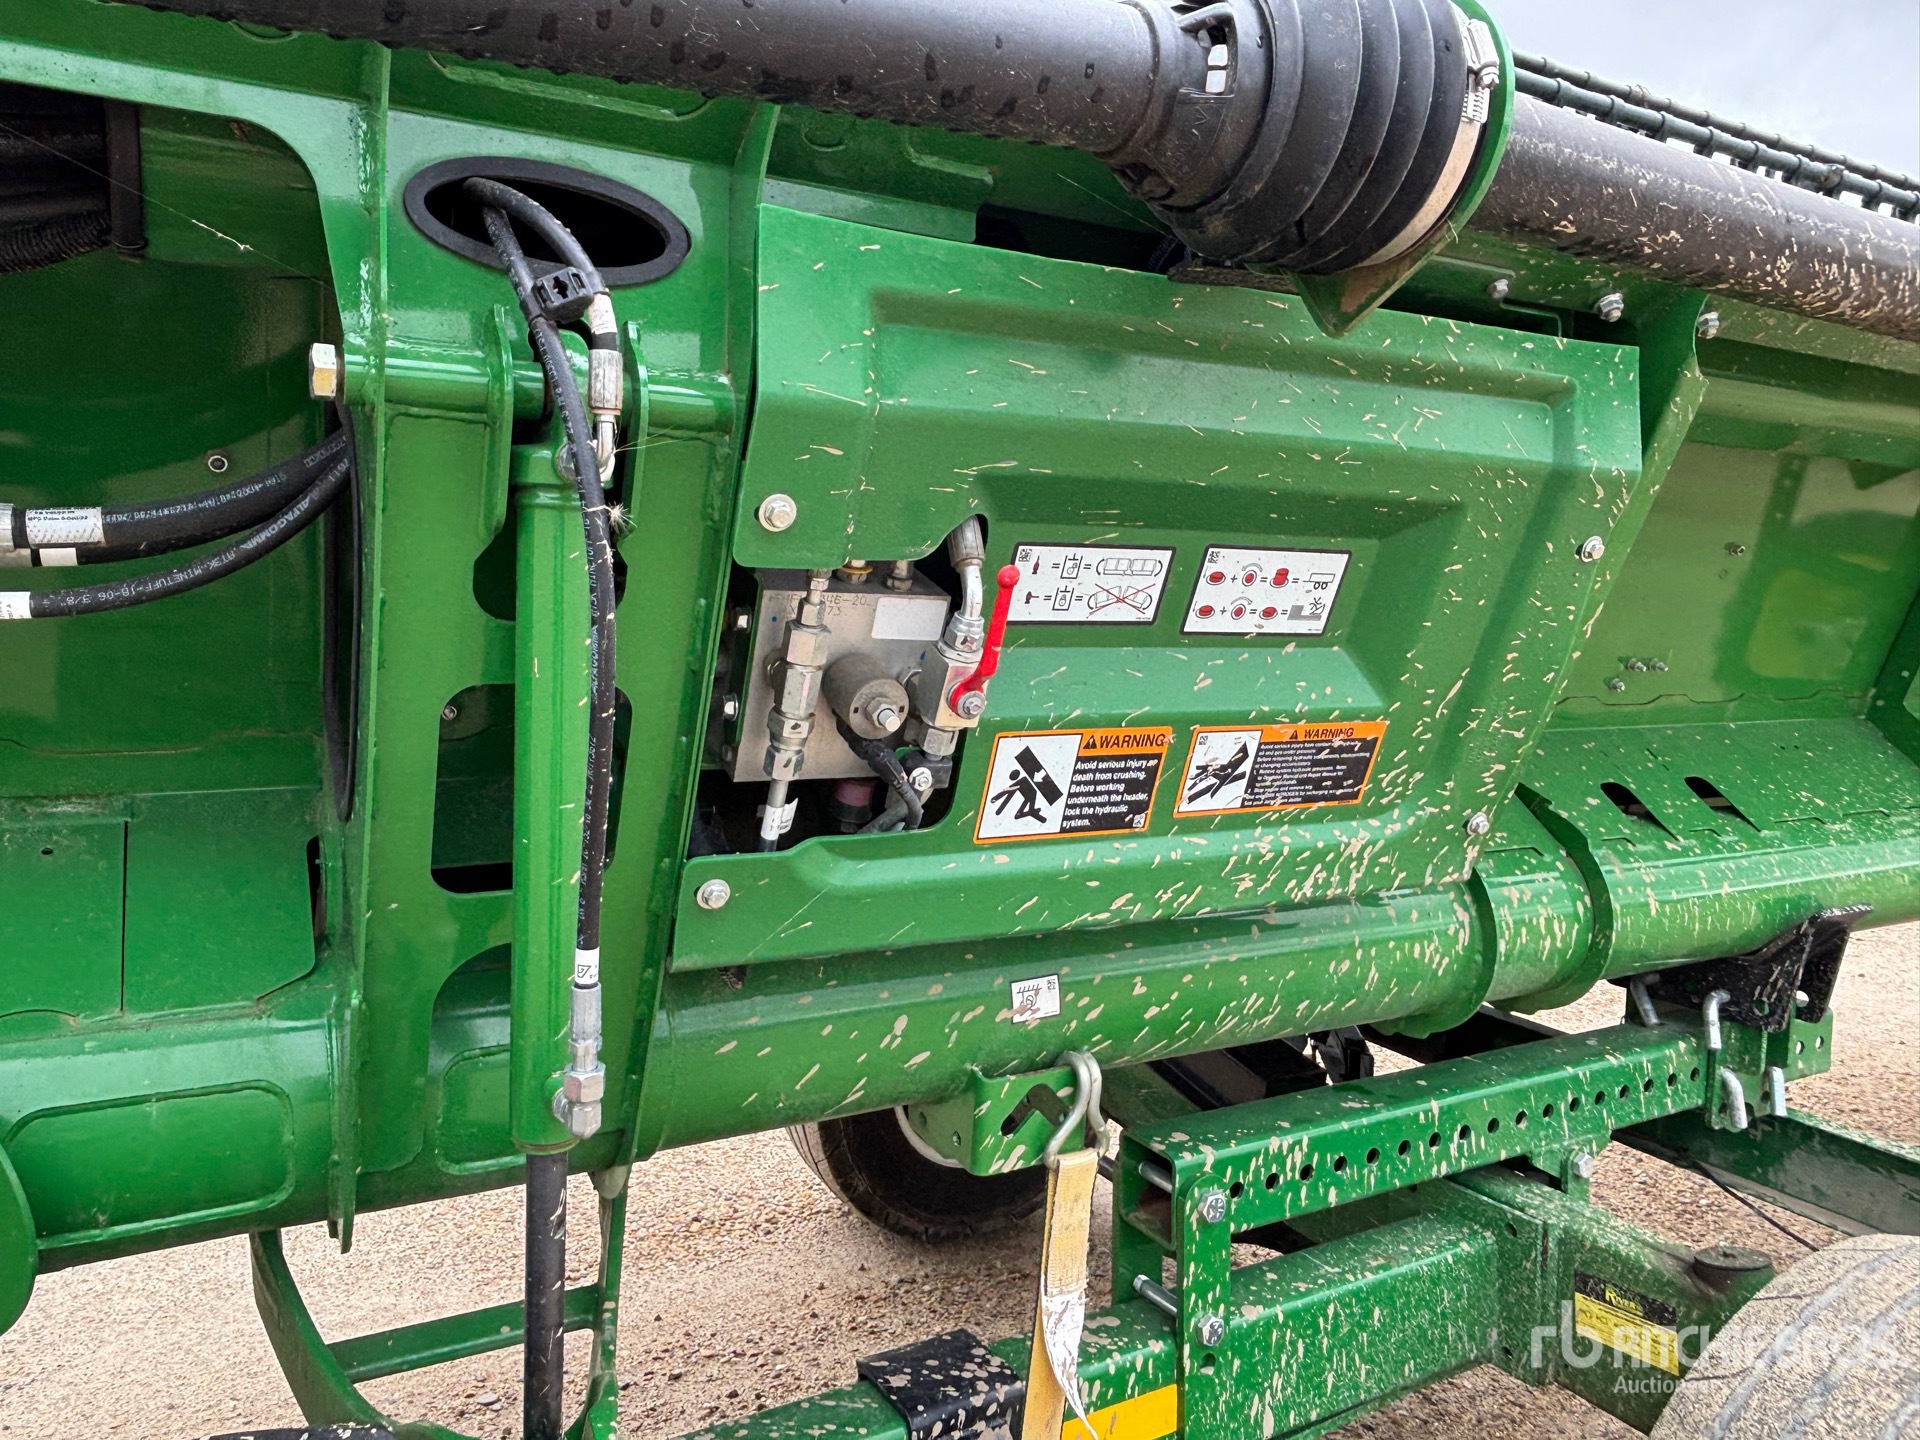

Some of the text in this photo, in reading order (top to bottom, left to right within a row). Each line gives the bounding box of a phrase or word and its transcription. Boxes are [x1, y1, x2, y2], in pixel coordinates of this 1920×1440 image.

[242, 497, 314, 550] ALFAGOMMA
[1304, 728, 1354, 739] WARNING
[1100, 734, 1166, 748] WARNING
[1075, 761, 1097, 770] Avoid
[1098, 761, 1125, 769] serious
[1126, 759, 1147, 769] injury
[1073, 769, 1146, 782] death from crushing.
[1070, 782, 1125, 793] Before working
[1067, 793, 1149, 806] underneath the header,
[1065, 804, 1128, 816] lock the hydraulic
[1062, 818, 1090, 829] system.
